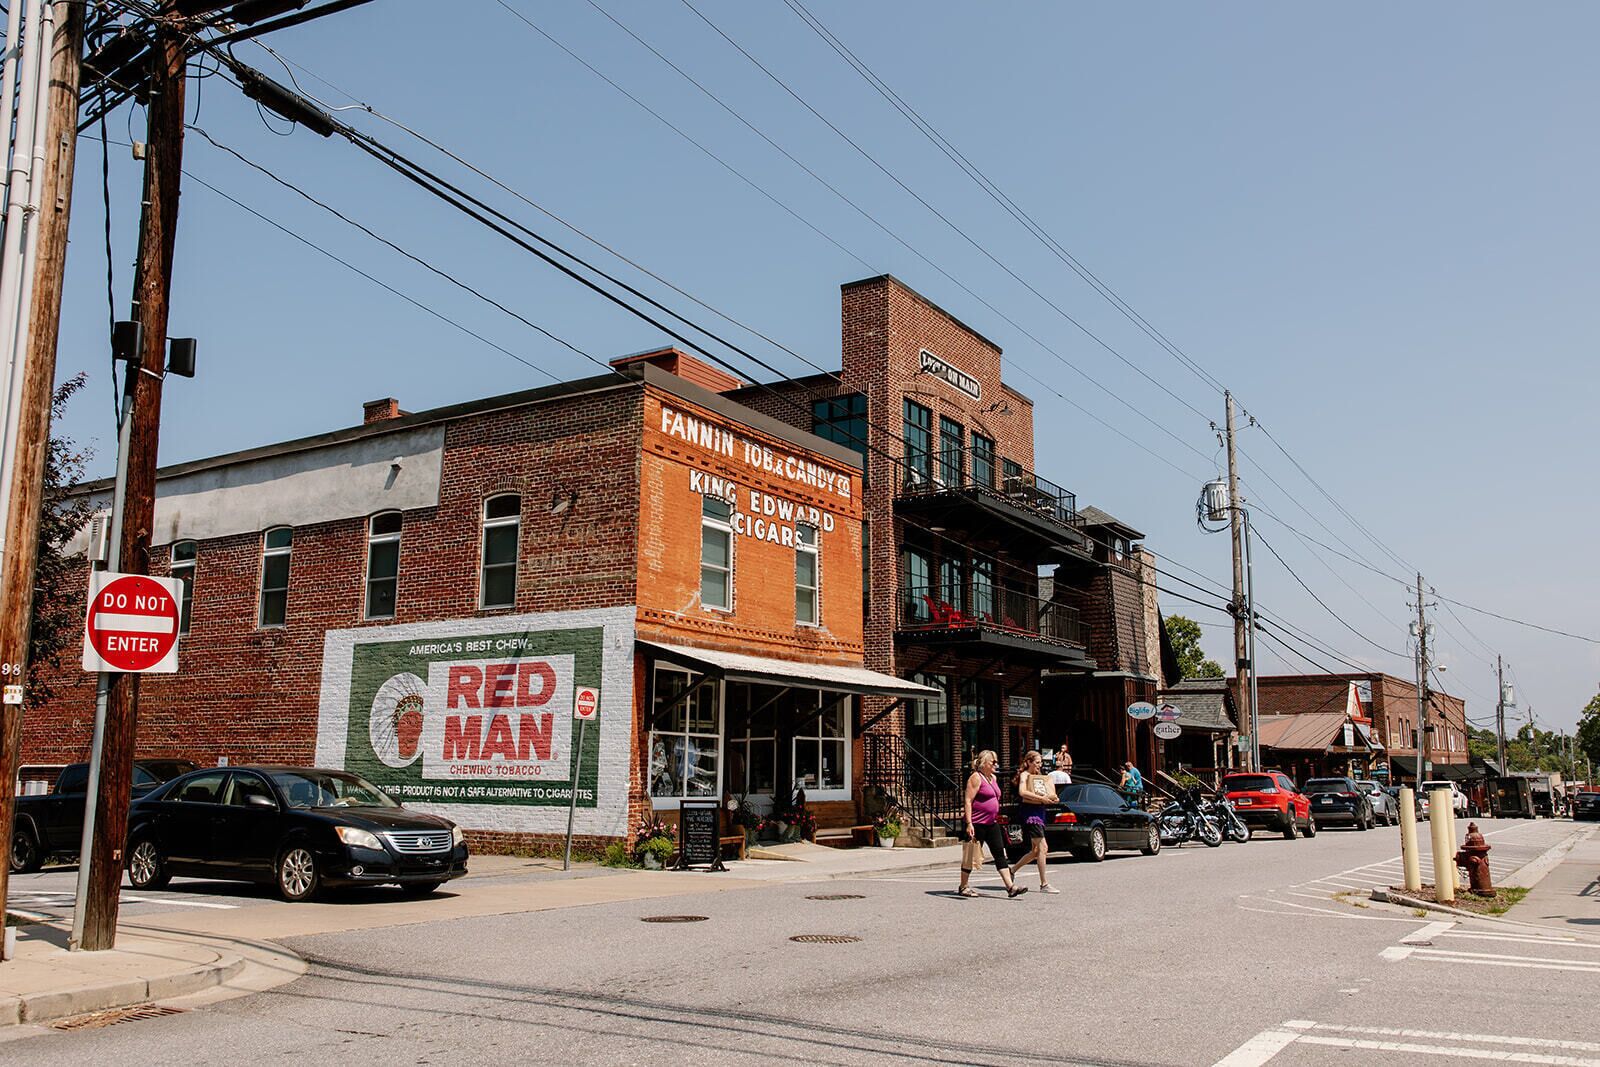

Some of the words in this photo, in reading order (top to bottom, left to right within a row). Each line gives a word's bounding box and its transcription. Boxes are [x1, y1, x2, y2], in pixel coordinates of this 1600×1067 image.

[959, 375, 978, 396] MAIN
[661, 407, 734, 458] FANNIN
[776, 460, 784, 477] &
[785, 456, 836, 493] CANDY
[689, 469, 737, 504] KING
[750, 490, 835, 532] EDWARD
[731, 512, 804, 550] CIGARS
[103, 593, 127, 609] DO
[135, 595, 168, 611] NOT
[107, 636, 159, 653] ENTER
[409, 641, 462, 655] AMERICA'S
[466, 640, 492, 651] BEST
[447, 661, 557, 708] RED
[443, 713, 554, 760] MAN
[1156, 725, 1181, 734] gather
[450, 764, 493, 775] CHEWING
[496, 765, 541, 776] TOBACCO
[384, 785, 400, 794] THIS
[403, 785, 433, 796] PRODUCT
[434, 786, 441, 796] IS
[443, 786, 458, 797] NOT
[460, 787, 466, 797] A
[467, 786, 485, 797] SAFE
[486, 787, 532, 797] ALTERNATIVE
[533, 788, 544, 798] TO
[546, 788, 593, 800] CIGARTTES
